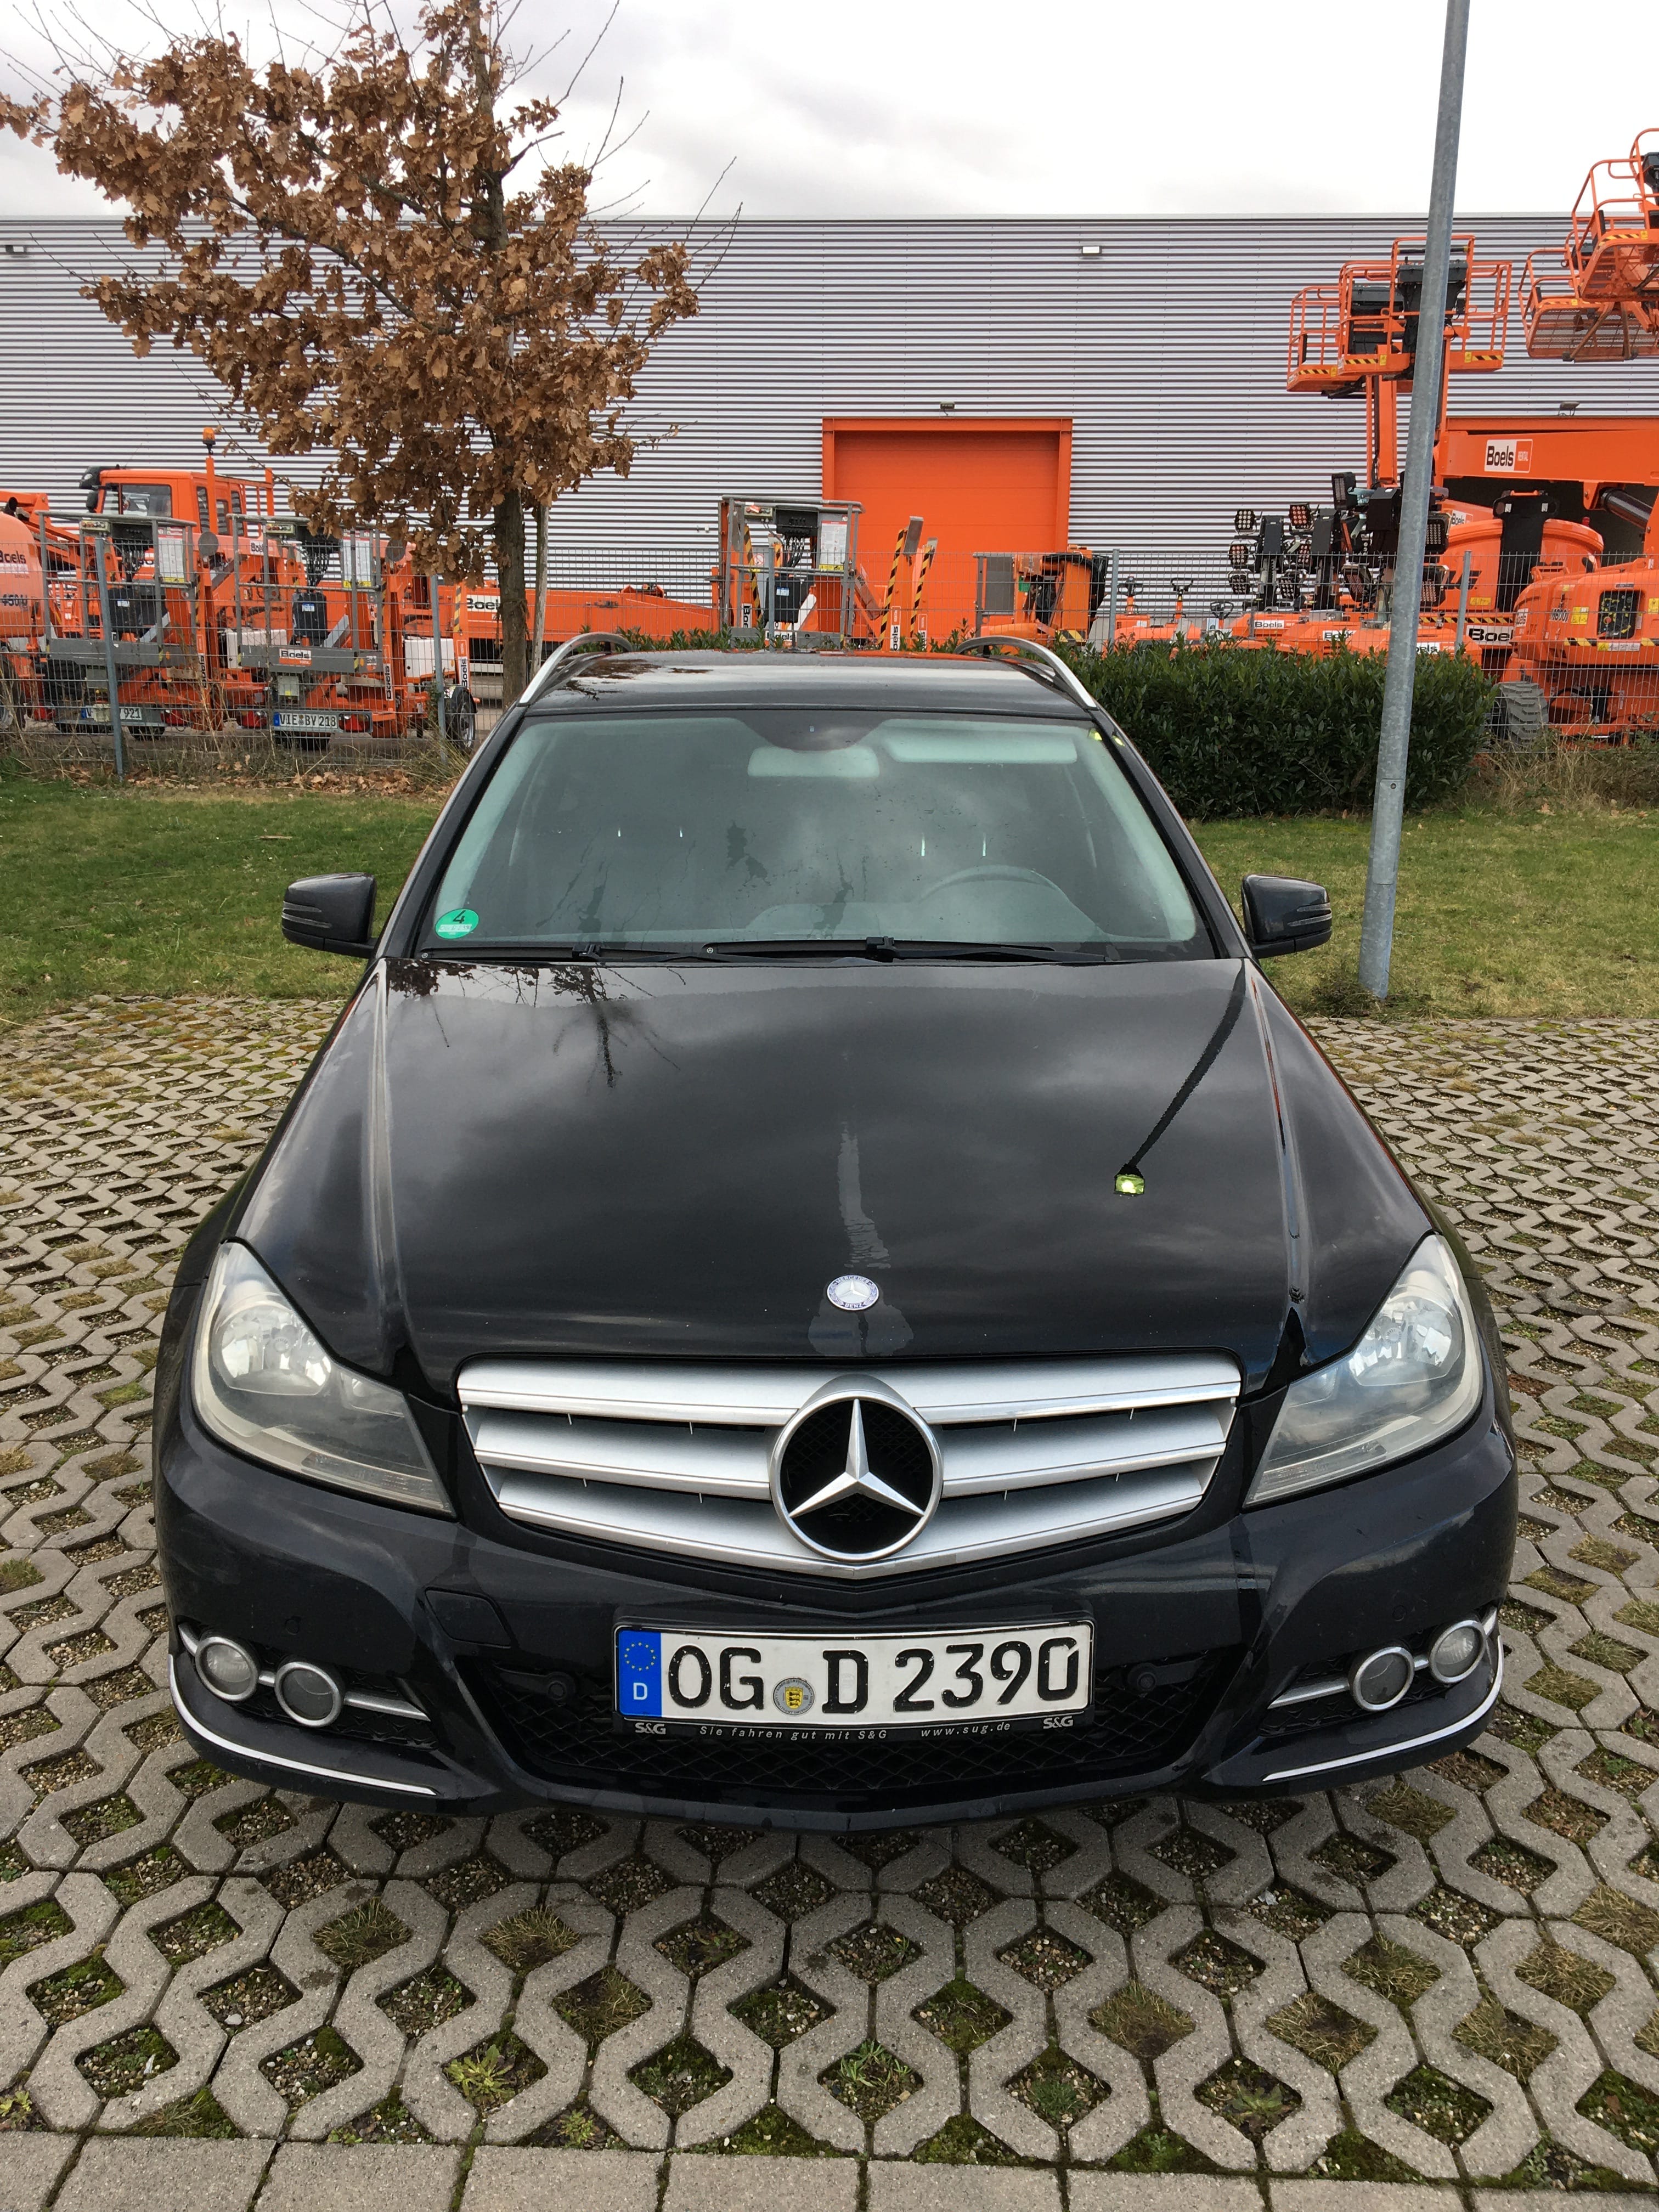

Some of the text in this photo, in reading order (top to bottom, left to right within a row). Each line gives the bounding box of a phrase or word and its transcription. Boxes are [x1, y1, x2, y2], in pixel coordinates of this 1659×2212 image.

[1487, 445, 1514, 466] Boels
[467, 599, 499, 610] Boel
[1469, 628, 1514, 641] Boel
[280, 650, 310, 659] Boels
[123, 708, 141, 718] 921
[280, 714, 336, 726] VIE BY 218
[453, 910, 466, 923] 4
[668, 1637, 1079, 1714] OG D 2390
[633, 1682, 647, 1700] D
[635, 1723, 666, 1735] S&G
[1043, 1716, 1074, 1729] S&G
[699, 1727, 887, 1741] Sie fahren gut mit S&G
[921, 1722, 1011, 1737] www.sug.de
